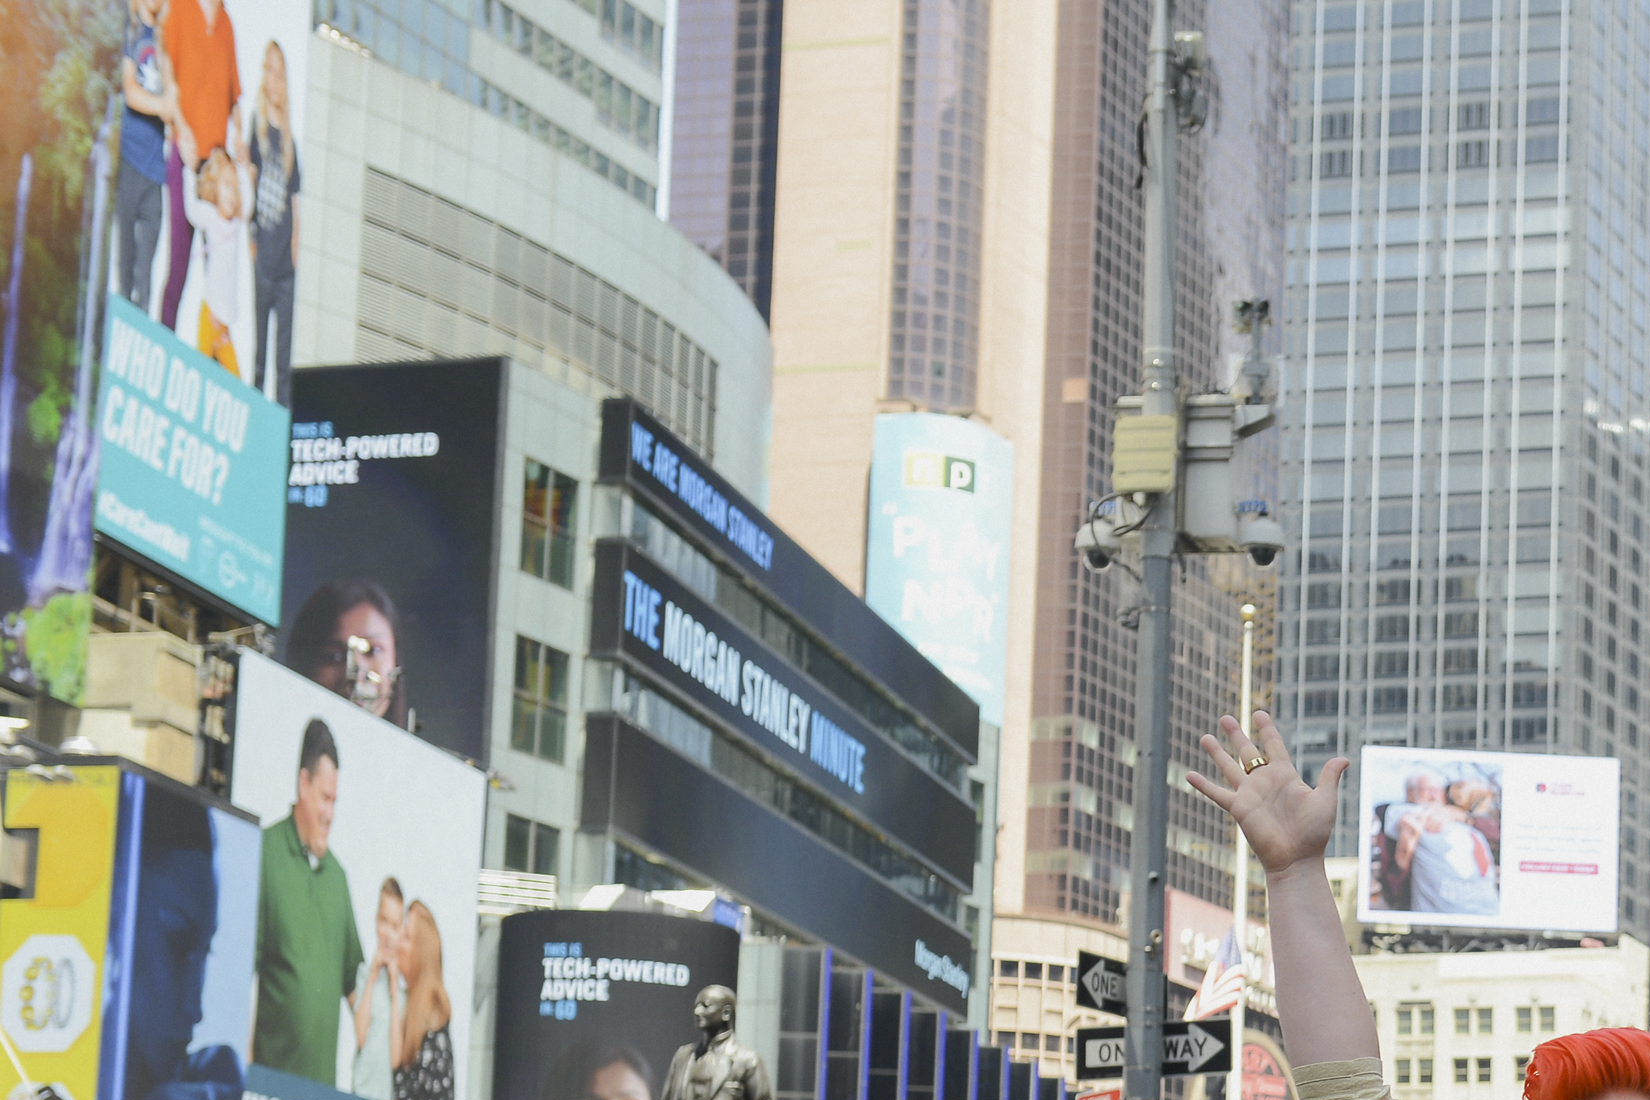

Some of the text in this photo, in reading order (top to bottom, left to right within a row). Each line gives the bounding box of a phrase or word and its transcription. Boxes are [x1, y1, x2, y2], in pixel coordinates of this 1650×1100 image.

[108, 317, 249, 453] WHO DO YOU
[103, 385, 230, 506] CARE FOR?
[290, 432, 439, 462] TECH-POWERED
[288, 460, 360, 486] ADVICE
[632, 421, 774, 571] WE ARE MORGAN STANLEY
[624, 569, 662, 650] THE
[663, 600, 741, 706] MORGAN
[741, 659, 811, 754] STANLEY
[810, 710, 867, 795] MINUTE
[543, 941, 583, 957] THIS IS
[541, 956, 690, 987] TECH-POWERED
[1091, 972, 1118, 997] ONE
[540, 978, 610, 1001] ADVICE
[1098, 1036, 1208, 1063] ON WAY
